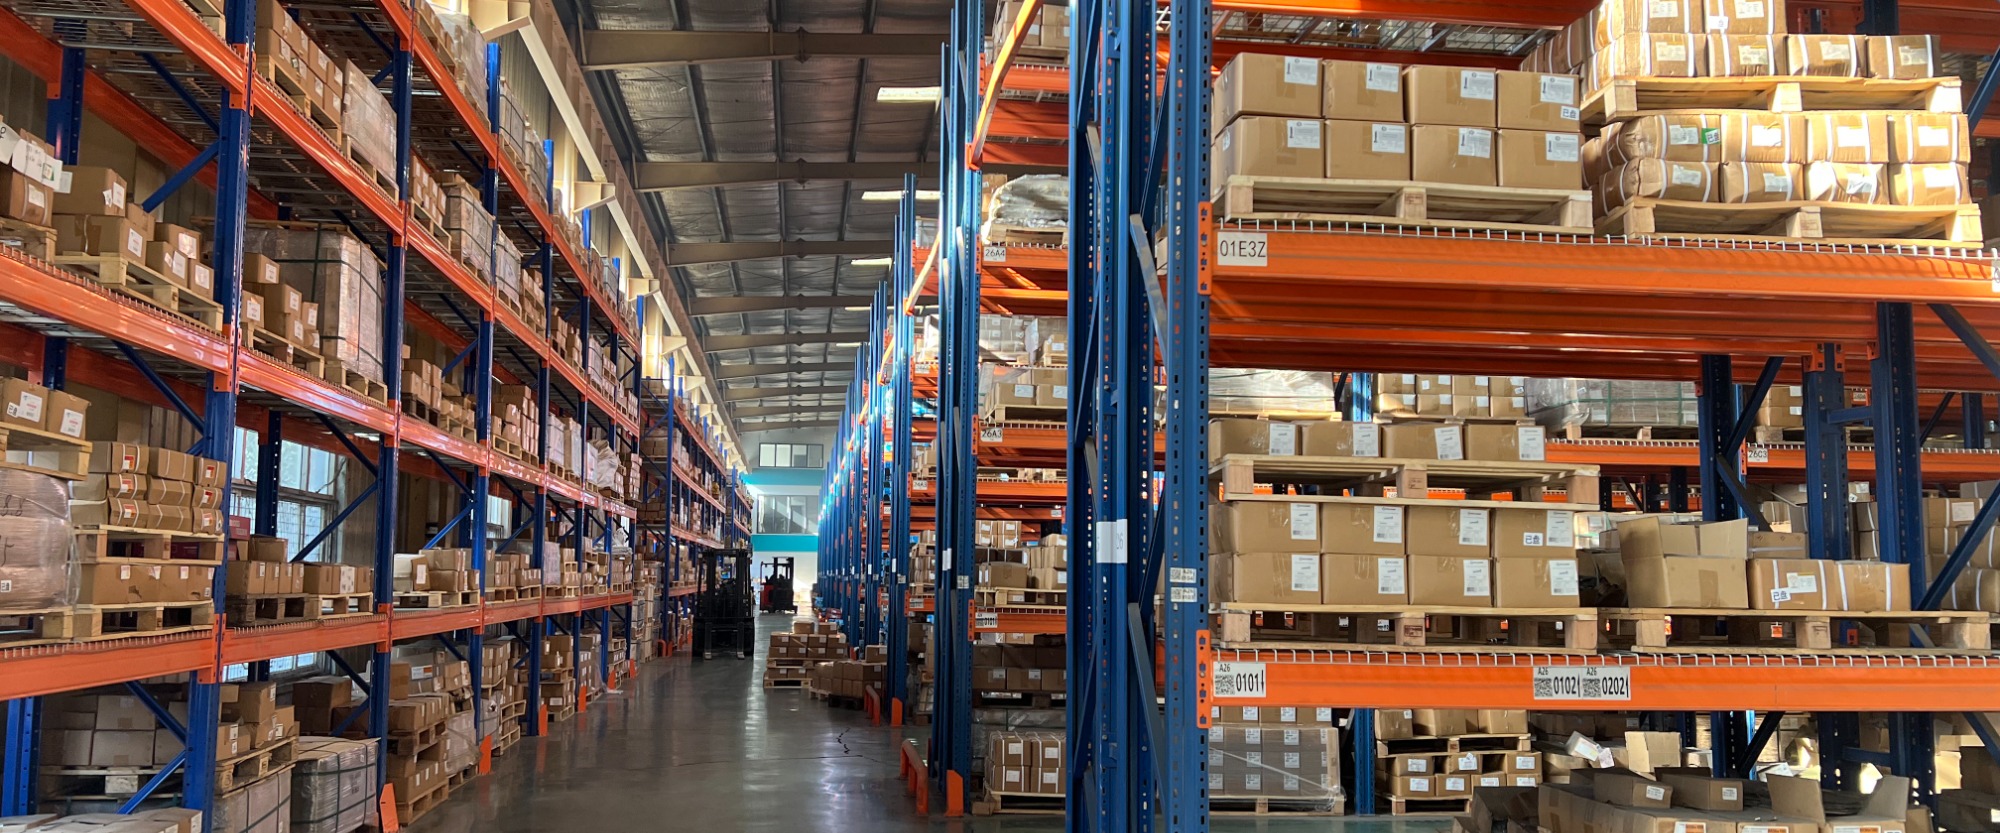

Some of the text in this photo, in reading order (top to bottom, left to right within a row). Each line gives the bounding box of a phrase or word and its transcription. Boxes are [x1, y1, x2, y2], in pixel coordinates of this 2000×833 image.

[985, 249, 1005, 257] 26A4
[1220, 240, 1266, 258] 01E3Z
[982, 430, 1002, 438] 26A3
[1219, 664, 1231, 672] A26
[1538, 667, 1548, 675] A26
[1586, 667, 1597, 675] A26
[1236, 673, 1259, 692] 0101
[1553, 676, 1576, 695] 0102
[1602, 677, 1625, 695] 0202
